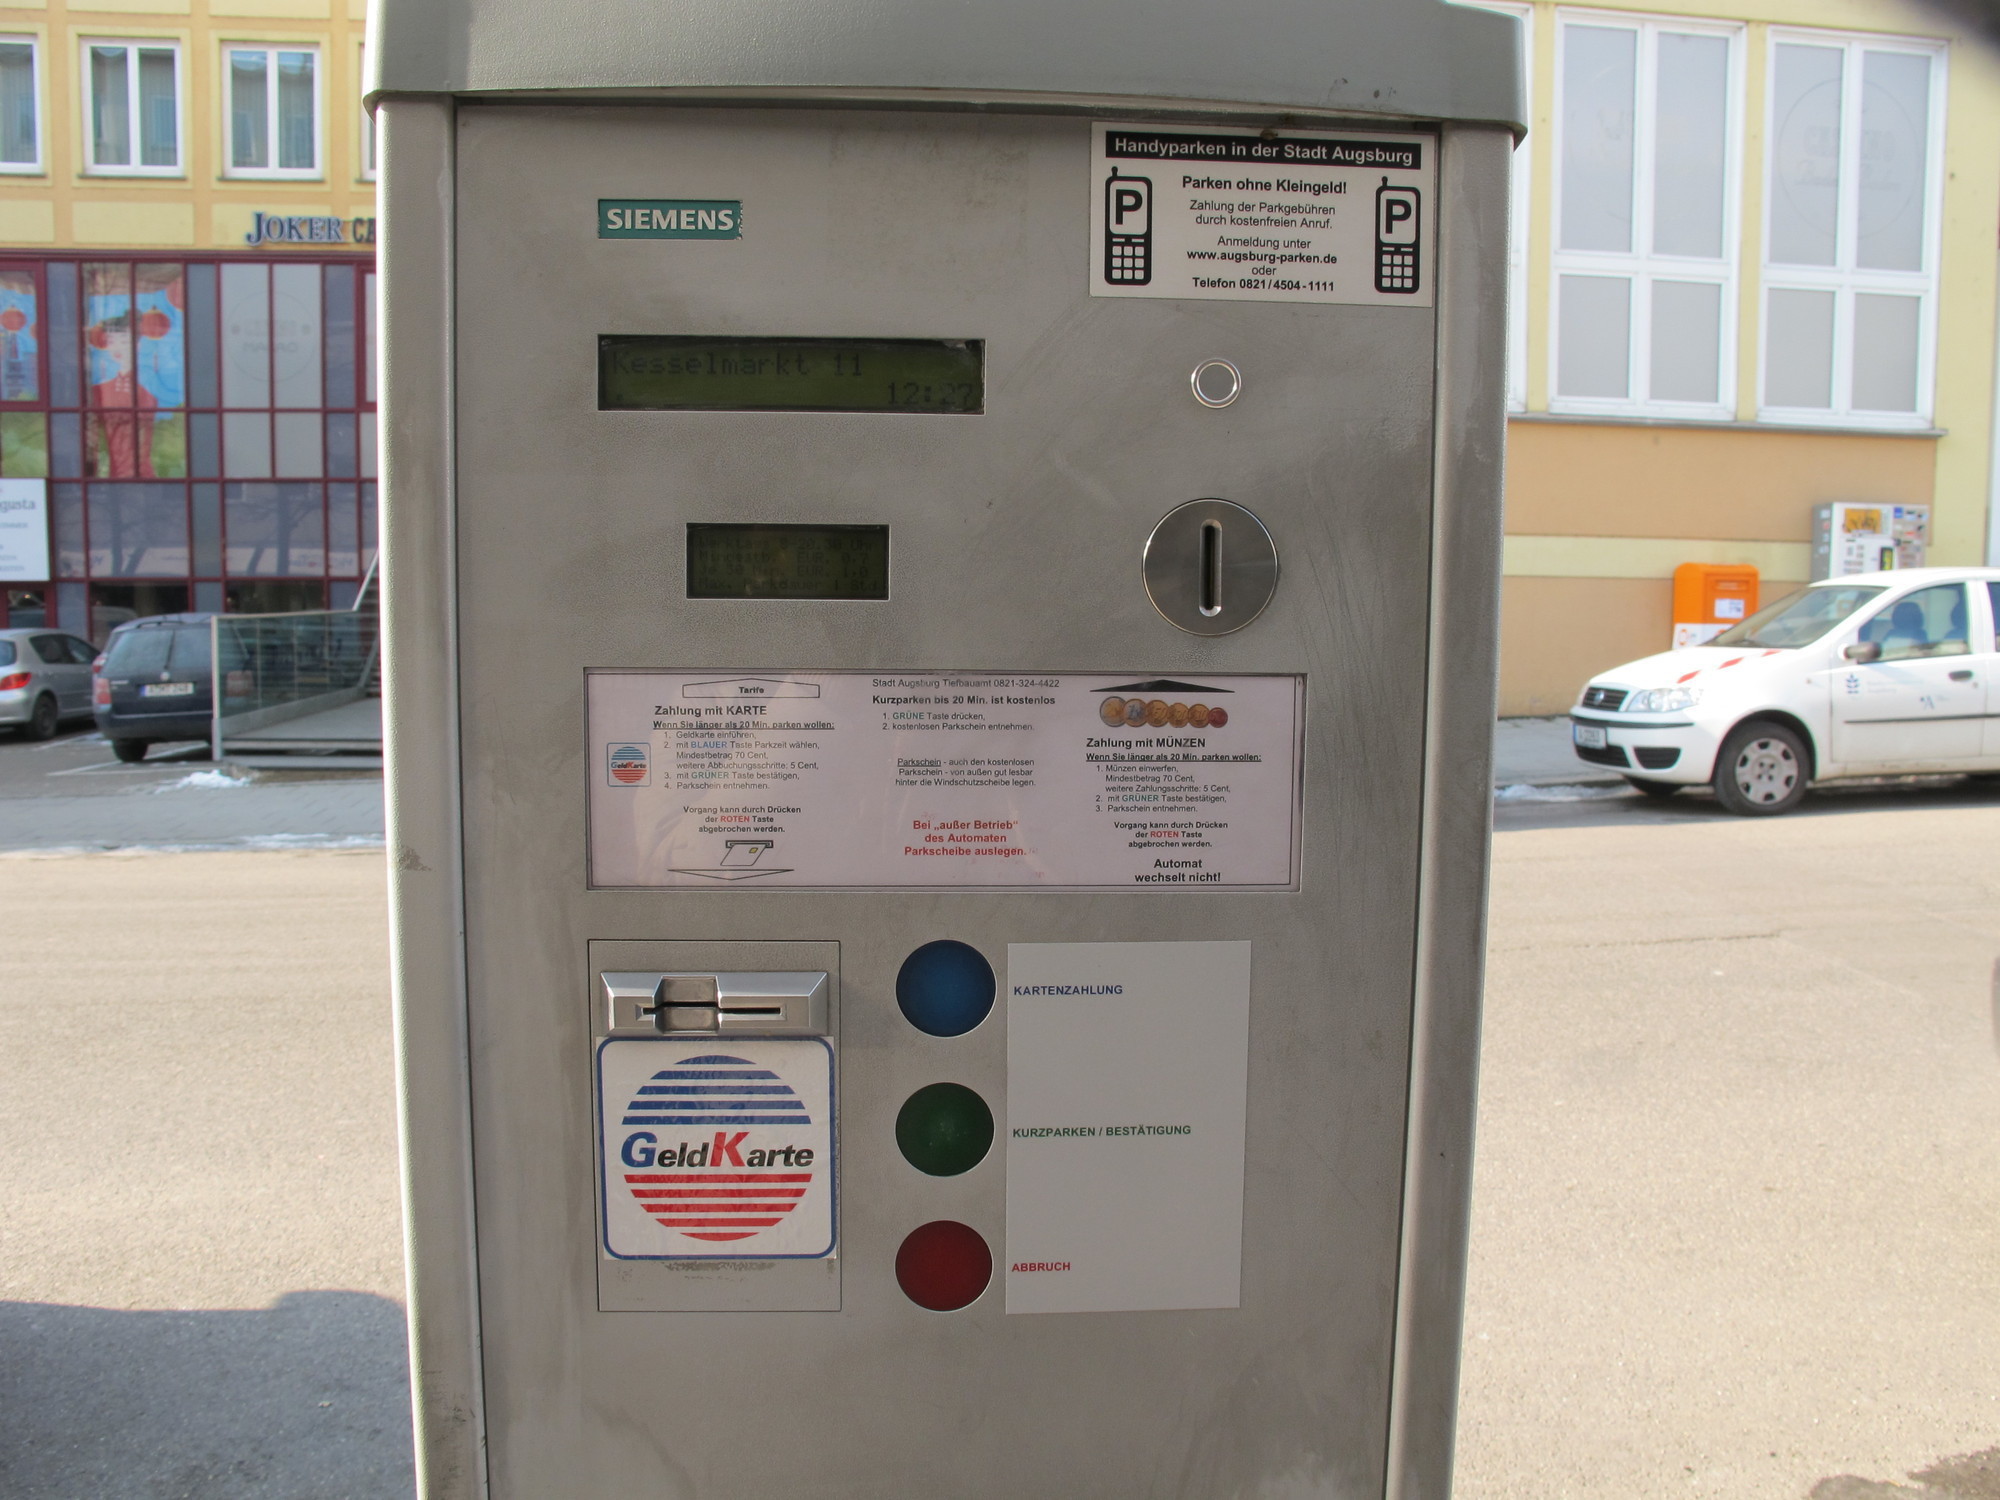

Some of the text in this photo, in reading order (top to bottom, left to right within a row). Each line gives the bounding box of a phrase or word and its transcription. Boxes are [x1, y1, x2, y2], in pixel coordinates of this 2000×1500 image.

[1115, 137, 1413, 166] Handyparken in der Stadt Augsburg
[1182, 176, 1347, 194] Parken ohne Kleingeld!
[1115, 189, 1142, 225] P
[1190, 200, 1336, 216] Zahlung der Parkgebühren
[607, 209, 734, 231] SIEMENS
[1386, 199, 1412, 233] P
[1196, 215, 1332, 229] durch kostenfreien Anruf.
[245, 211, 343, 244] JOKER
[1217, 236, 1311, 249] Anmeldung unter
[1187, 250, 1337, 264] www.augsburg-parken.de
[1252, 265, 1277, 275] oder
[1192, 277, 1236, 289] Telefon
[612, 352, 863, 376] Kesselmarkt 11
[898, 680, 939, 689] Augsburg
[739, 686, 764, 694] Tarife
[872, 696, 1055, 706] Kurzparken bis 20 Min. ist kostenlos
[655, 706, 767, 717] Zahlung mit KARTE
[893, 712, 924, 720] GRÜNE
[951, 713, 985, 721] drücken,
[696, 721, 722, 730] länger
[773, 721, 801, 730] parken
[676, 731, 756, 740] Geldkarte einführen,
[789, 741, 820, 750] wählen,
[1086, 736, 1205, 749] Zahlung mit MÜNZEN
[677, 752, 732, 760] Mindestbetrag
[748, 752, 768, 760] Cent,
[1128, 753, 1153, 762] länger
[1202, 754, 1230, 762] parken
[611, 761, 646, 769] GeldKarte
[708, 762, 788, 771] Abbuchungsschritte:
[798, 762, 819, 770] Cent,
[1139, 765, 1178, 773] einwerfen,
[691, 770, 729, 779] GRÜNER
[757, 772, 799, 781] bestätigen,
[994, 770, 1007, 778] gut
[1012, 779, 1036, 788] legen.
[1106, 775, 1160, 784] Mindestbetrag
[1175, 775, 1195, 783] Cent,
[1136, 785, 1201, 794] Zahlungsschritte:
[1122, 794, 1159, 802] GRÜNER
[1185, 795, 1226, 804] bestätigen,
[683, 806, 717, 815] Vorgang
[913, 821, 931, 829] Bei
[1114, 822, 1147, 830] Vorgang
[699, 826, 751, 834] abgebrochen
[925, 834, 1006, 842] des Automaten
[1128, 841, 1179, 849] abgebrochen
[904, 847, 1027, 857] Parkscheibe auslegen.
[1154, 859, 1202, 868] Automat
[1135, 873, 1221, 882] wechselt nicht!
[1014, 984, 1123, 996] KARTENZAHLUNG
[1013, 1124, 1191, 1138] KURZPARKEN BESTÄTIGUNG
[621, 1131, 814, 1168] GeldKarte
[1011, 1262, 1070, 1273] ABBRUCH
